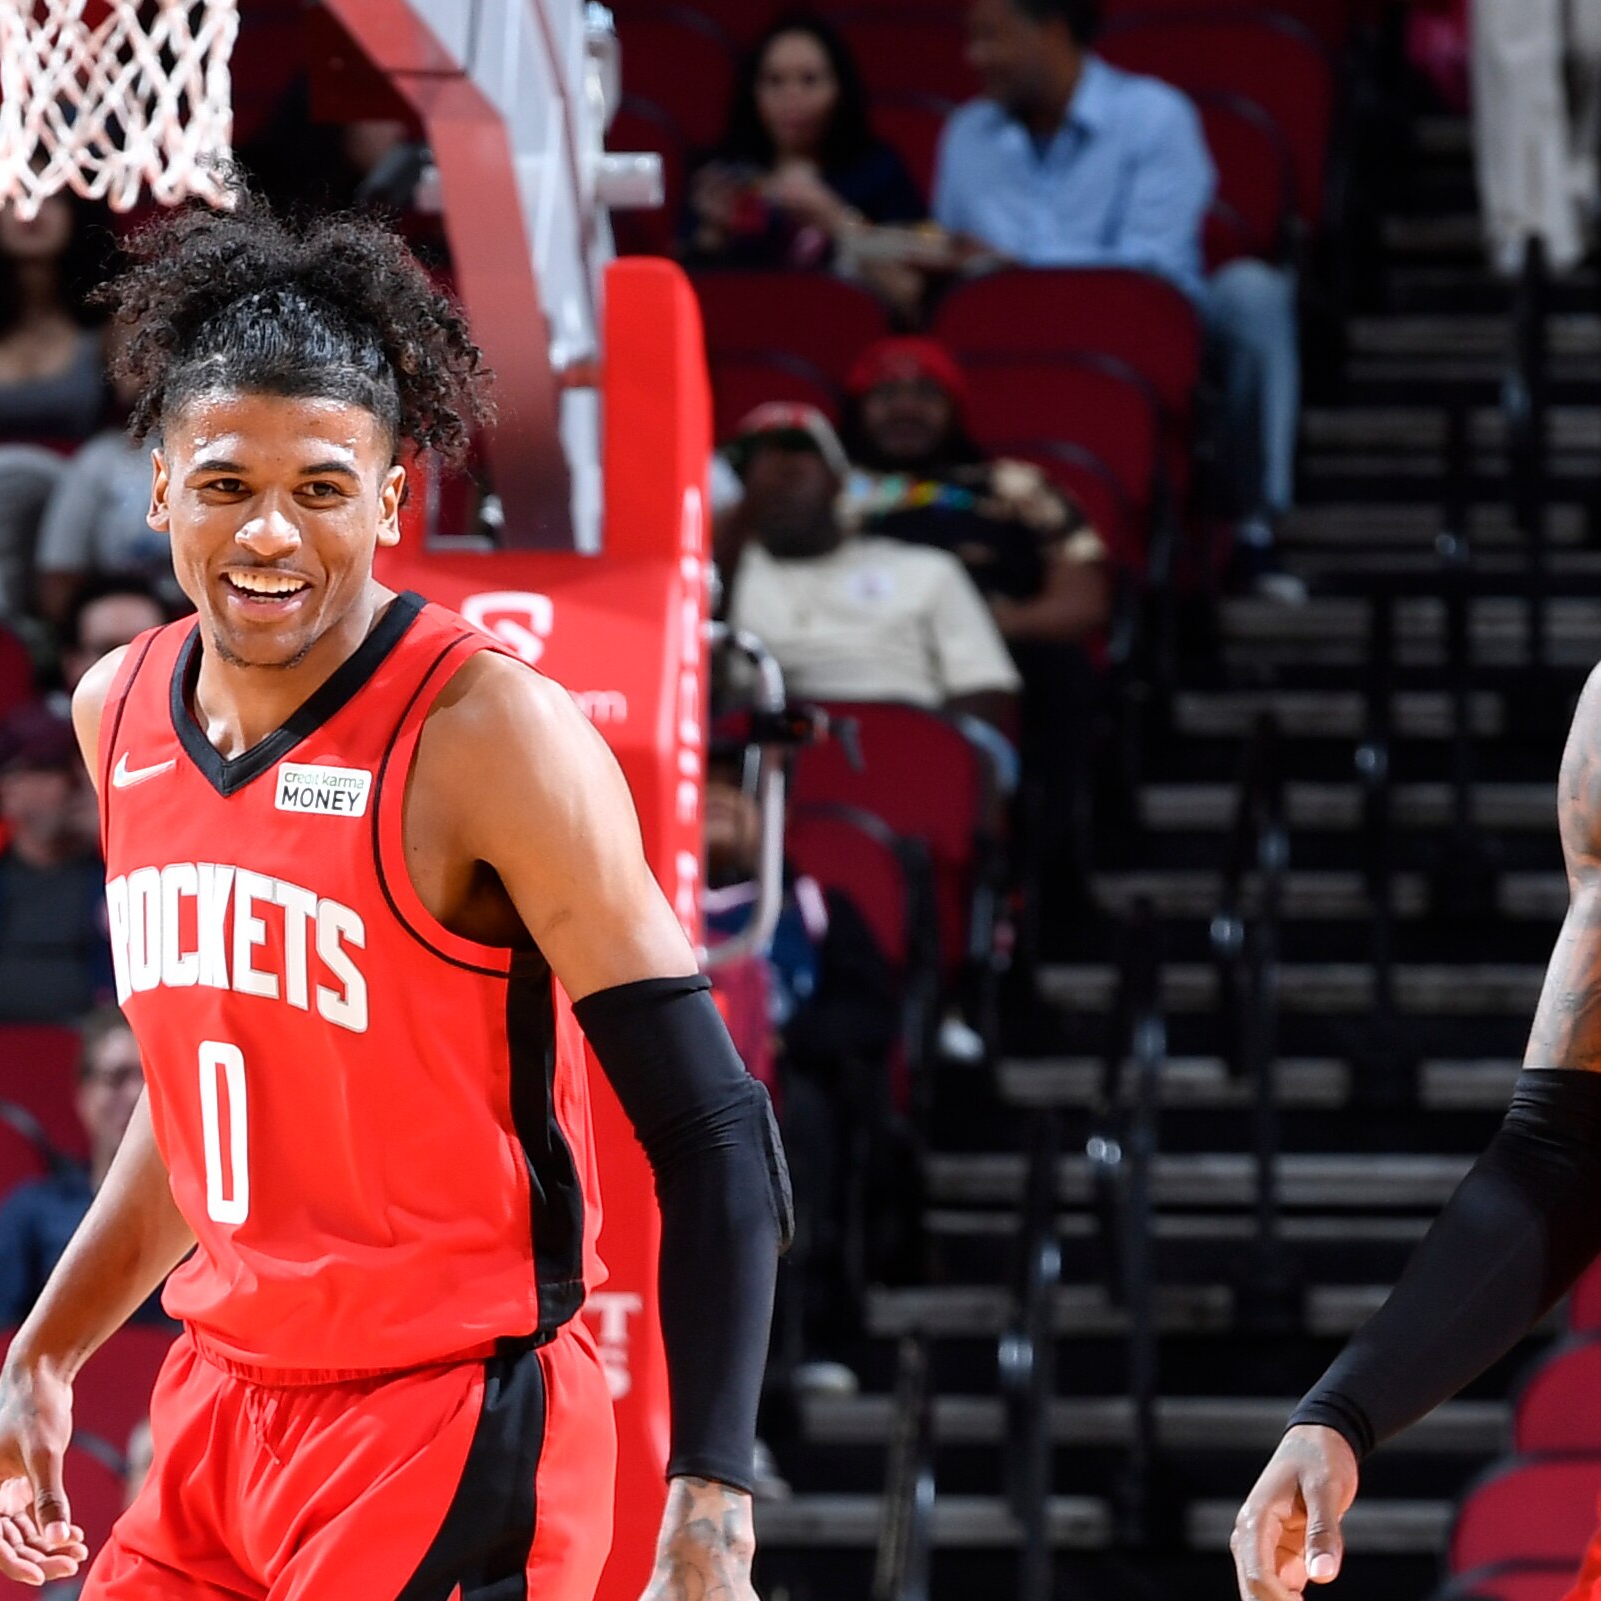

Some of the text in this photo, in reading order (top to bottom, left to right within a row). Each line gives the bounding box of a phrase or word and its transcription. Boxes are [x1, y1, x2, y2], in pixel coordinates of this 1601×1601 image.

[281, 785, 361, 812] MONEY
[322, 772, 365, 790] karma
[104, 861, 369, 1034] ROCKETS
[198, 1039, 249, 1225] 0
